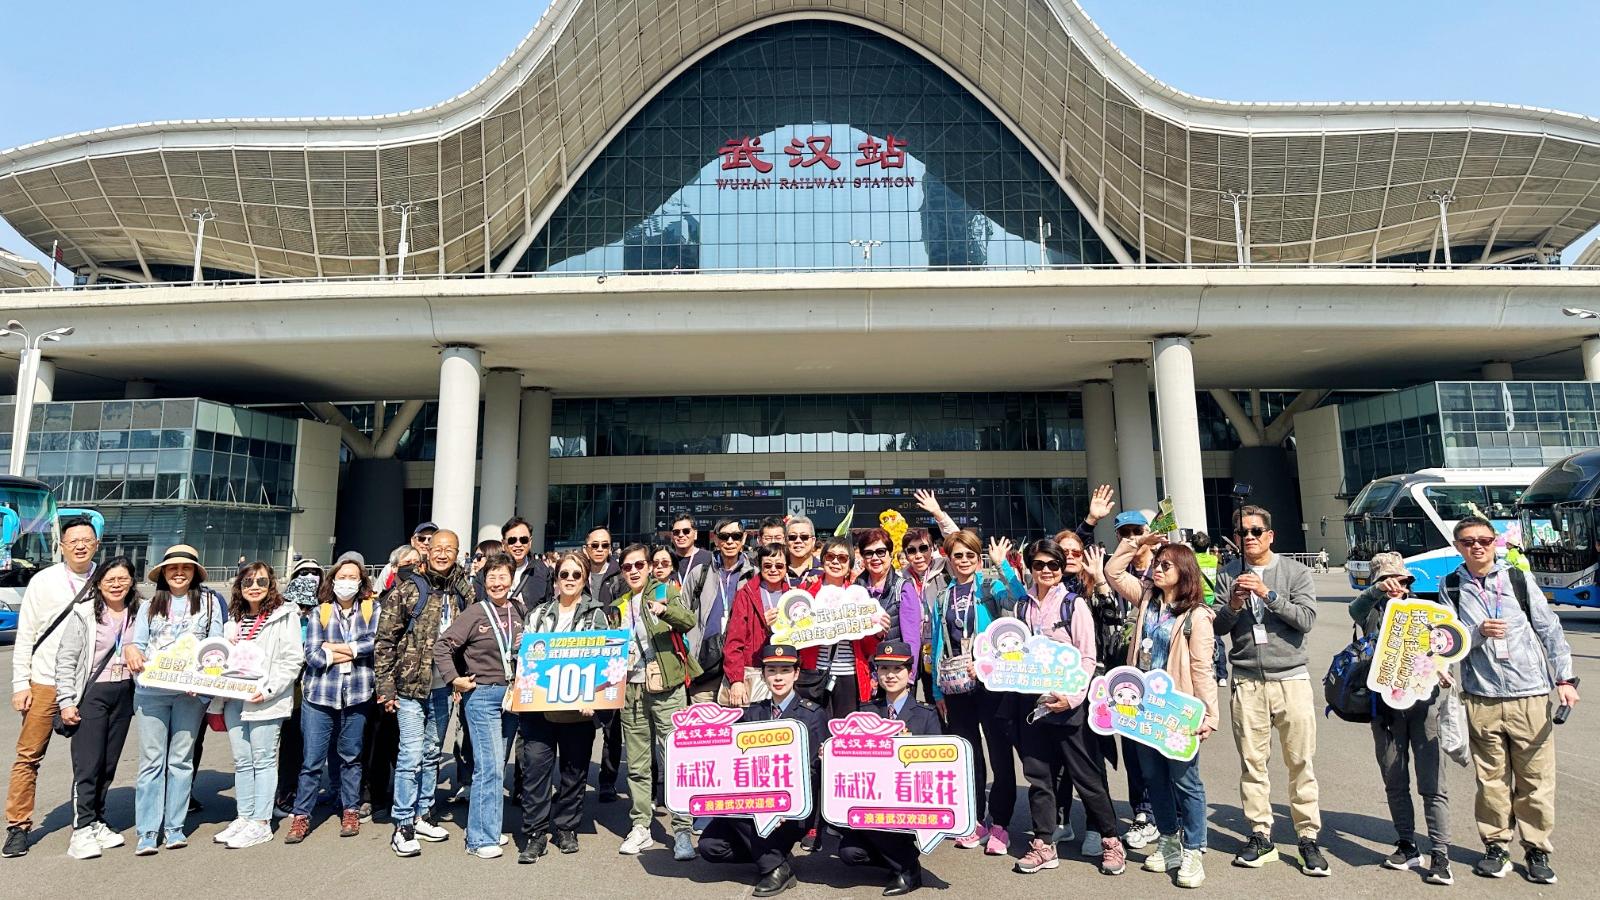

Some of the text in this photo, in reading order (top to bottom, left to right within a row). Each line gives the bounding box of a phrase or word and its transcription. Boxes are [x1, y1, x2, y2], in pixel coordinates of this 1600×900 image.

[717, 133, 908, 173] 武汉站
[716, 176, 915, 190] WUHAN RAILWAY STATION
[806, 498, 834, 508] 出站口
[519, 663, 617, 704] 第 101 車
[676, 727, 731, 739] 武汉车站
[741, 732, 790, 745] GO GO GO
[833, 738, 892, 749] 武汉车站
[903, 748, 954, 759] GO GO GO
[704, 797, 775, 811] 浪漫武汉欢迎您
[864, 812, 938, 825] 浪漫武汉欢迎您
